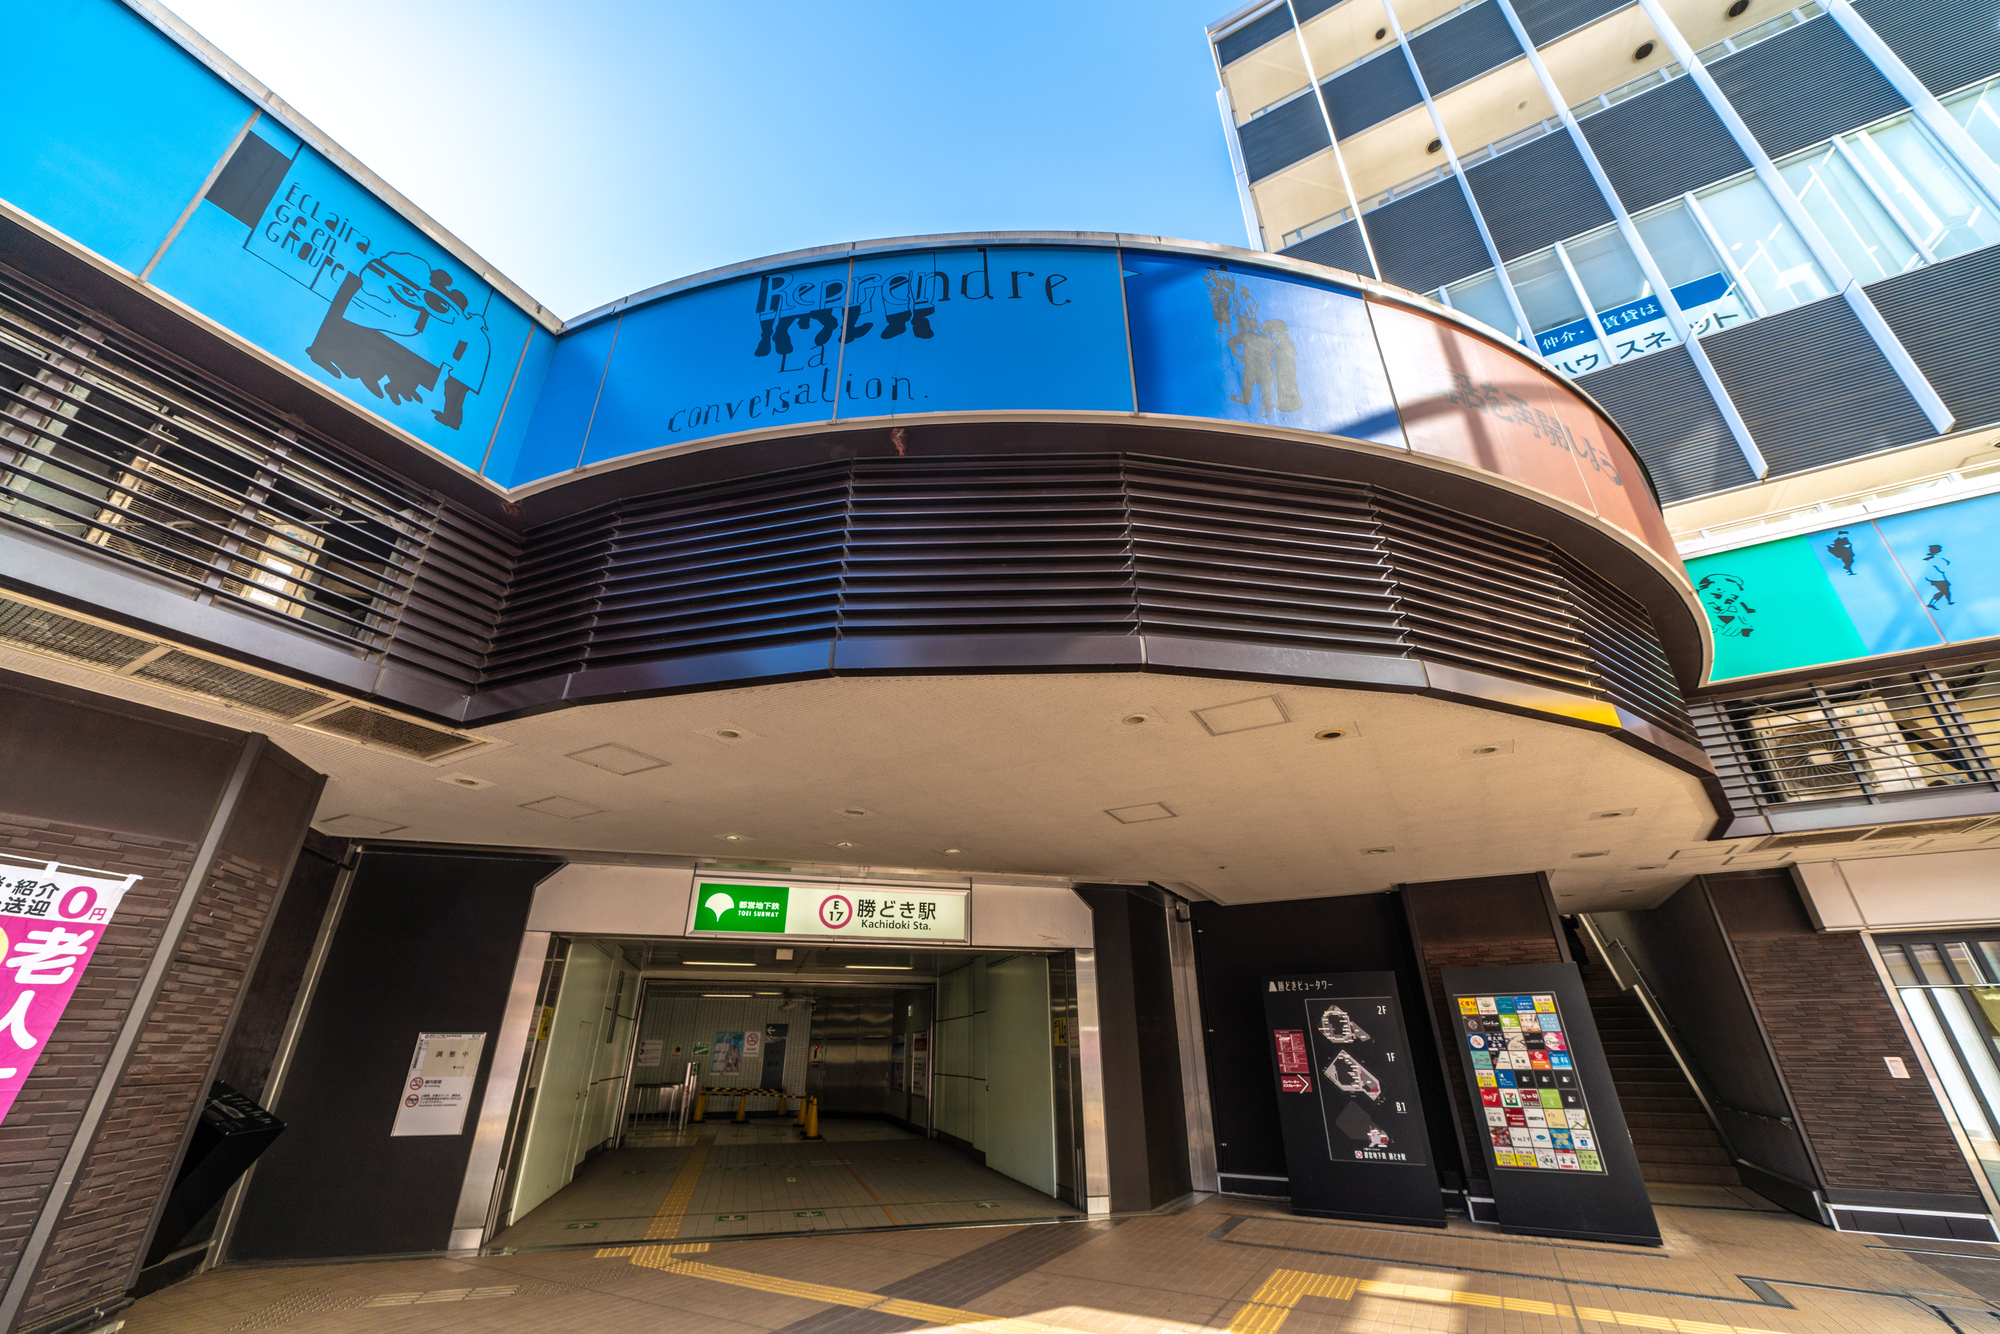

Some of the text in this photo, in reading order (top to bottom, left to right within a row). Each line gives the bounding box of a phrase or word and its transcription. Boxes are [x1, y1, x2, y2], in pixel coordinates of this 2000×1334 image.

[311, 228, 336, 258] en
[755, 249, 1071, 314] Reprendre
[777, 345, 829, 373] La
[0, 875, 60, 899] ・紹介
[739, 901, 780, 910] 都営地下鉄
[833, 900, 840, 910] E
[857, 899, 936, 921] 勝どき駅
[829, 911, 844, 922] 17
[861, 919, 931, 931] Kachidoki Sta.
[1277, 980, 1334, 992] 勝どきビュータワー
[0, 927, 95, 1079] 老人
[1377, 1005, 1387, 1015] 2F
[1386, 1052, 1396, 1062] 1F
[1395, 1101, 1407, 1112] B1
